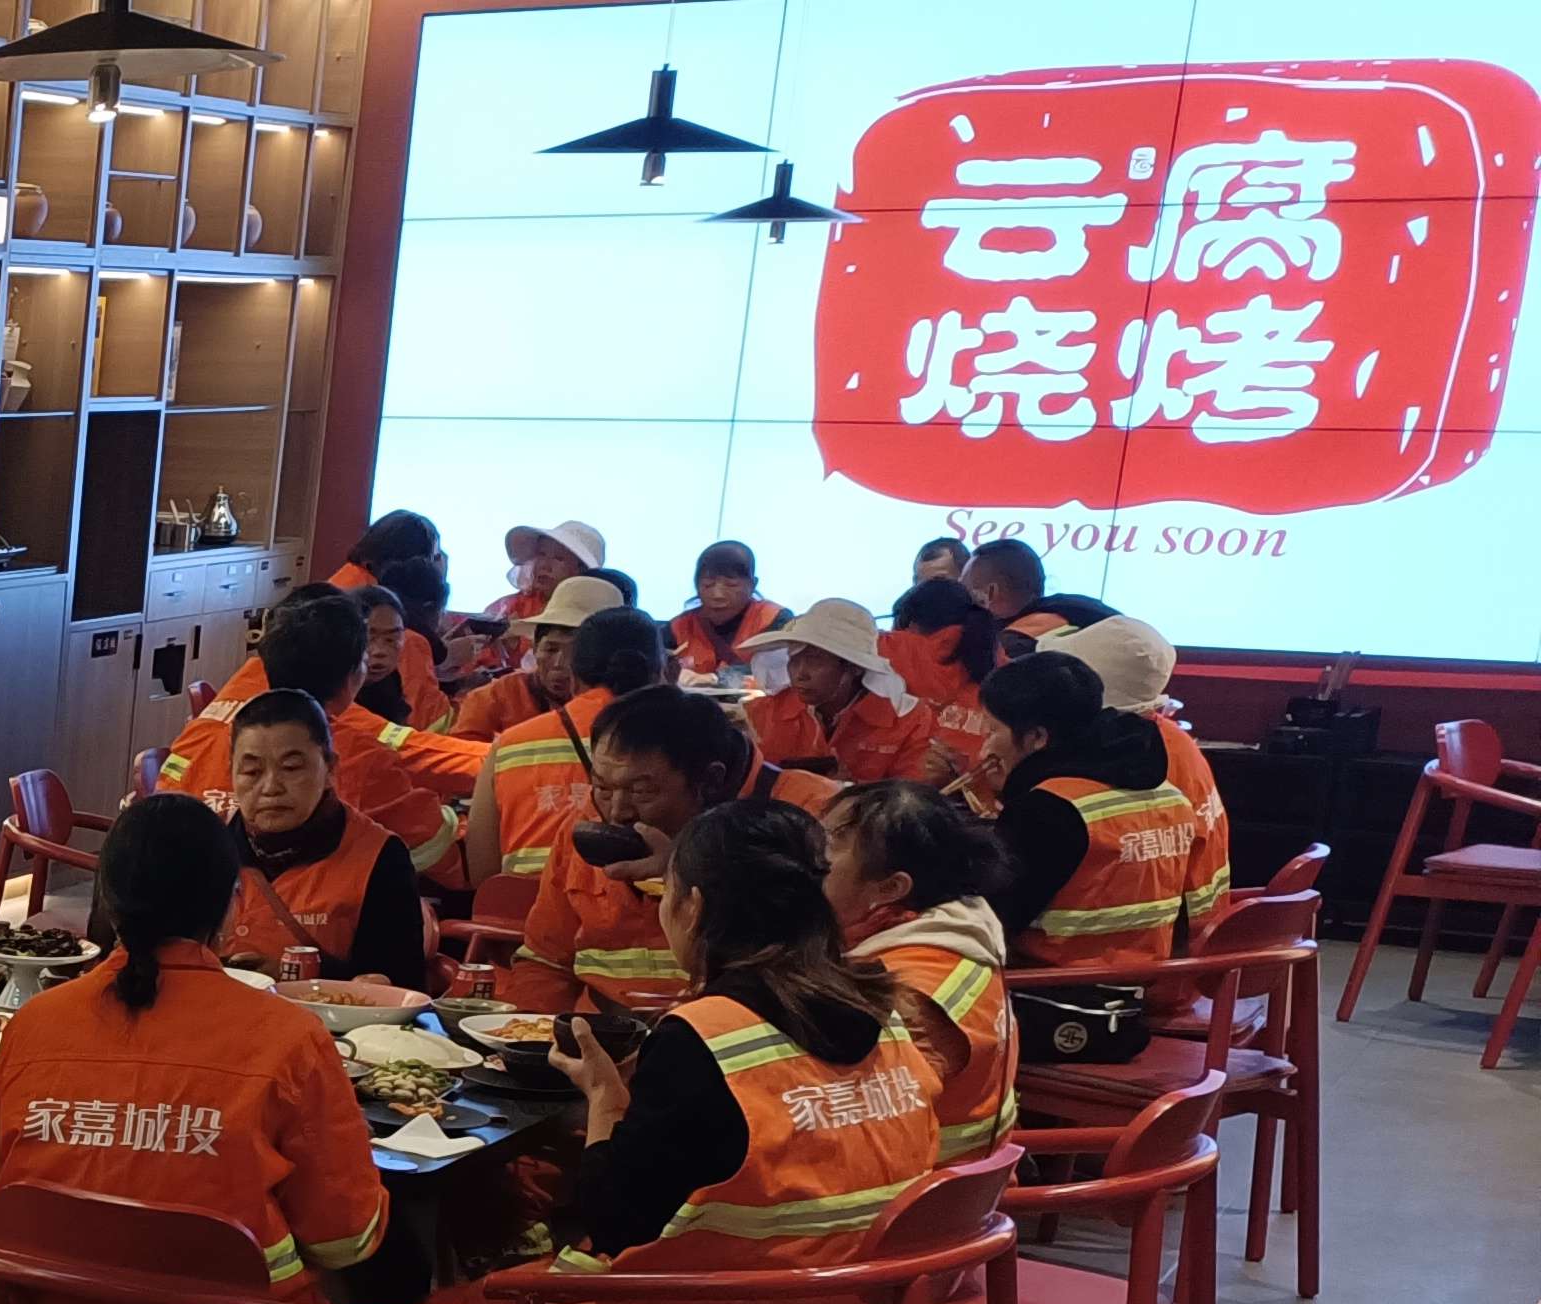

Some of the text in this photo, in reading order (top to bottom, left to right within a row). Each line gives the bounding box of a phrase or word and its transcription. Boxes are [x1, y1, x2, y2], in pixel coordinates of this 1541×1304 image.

[920, 129, 1360, 284] 云腐
[900, 295, 1335, 444] 烧烤
[1038, 521, 1139, 559] you
[1154, 526, 1288, 557] soon
[22, 1096, 224, 1158] 家嘉城投
[781, 1064, 928, 1131] 家嘉城投
